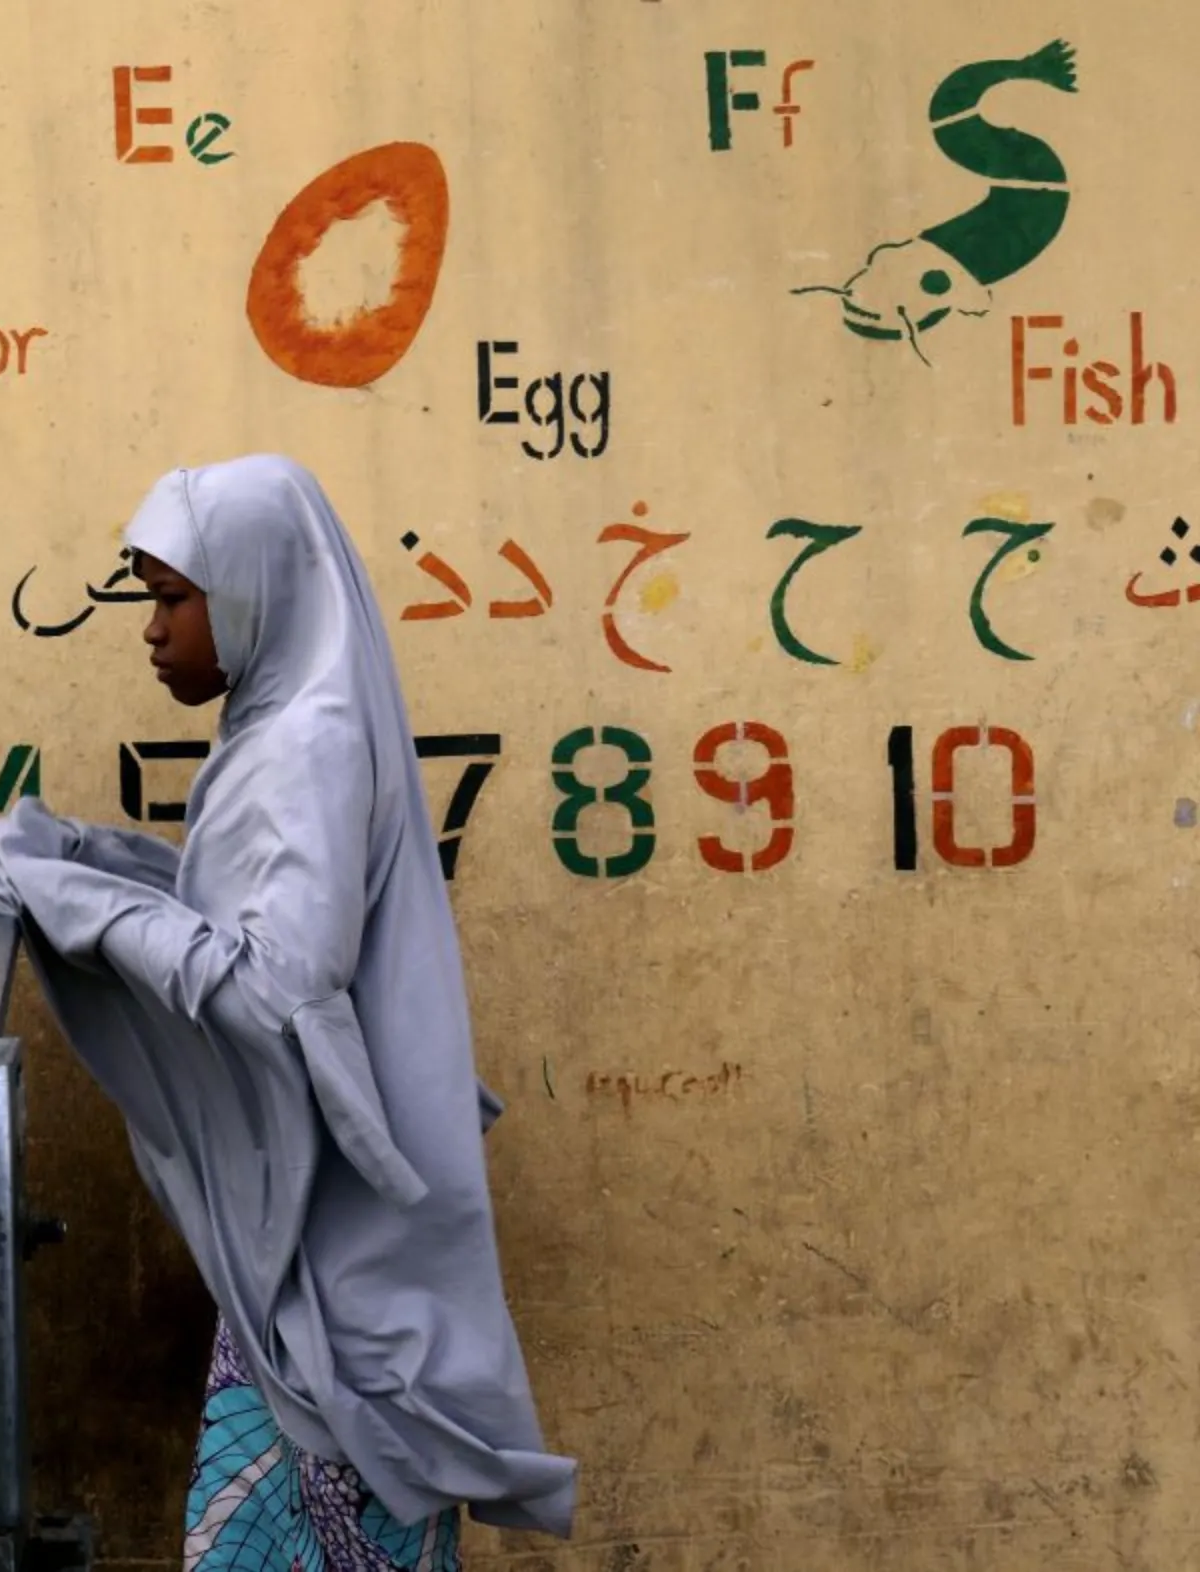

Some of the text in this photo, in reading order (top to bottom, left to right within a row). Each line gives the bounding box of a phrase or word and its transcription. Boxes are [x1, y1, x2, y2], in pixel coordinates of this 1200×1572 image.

[477, 340, 610, 460] Egg
[1011, 312, 1176, 425] Fish
[400, 531, 472, 620] ذ
[489, 540, 552, 618] د
[597, 502, 690, 673] خ
[766, 518, 863, 665] ح
[962, 517, 1055, 661] ج
[413, 733, 501, 880] 7
[552, 726, 656, 879] 8
[694, 722, 794, 873] 9
[888, 725, 1036, 872] 10
